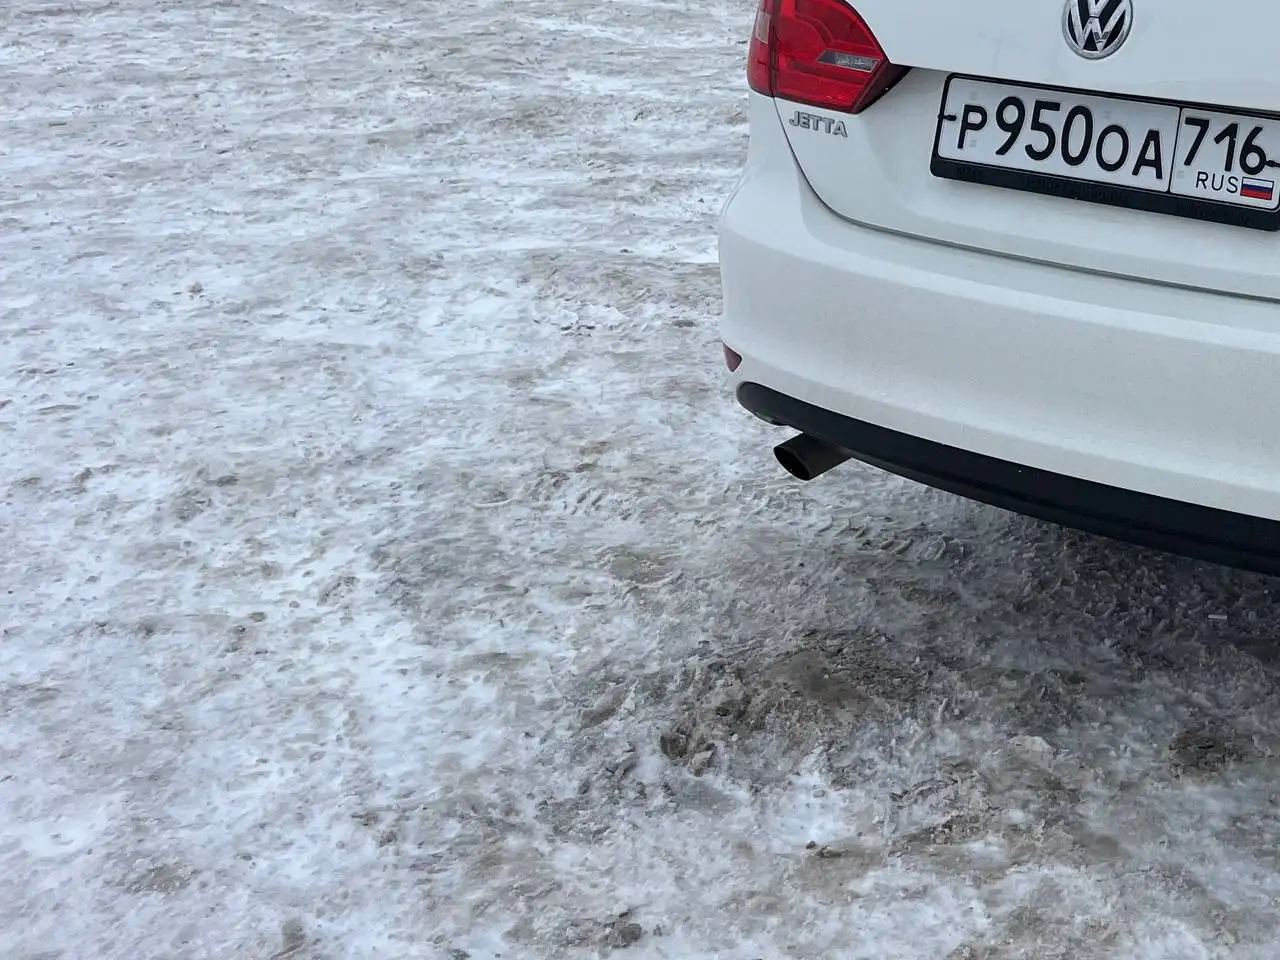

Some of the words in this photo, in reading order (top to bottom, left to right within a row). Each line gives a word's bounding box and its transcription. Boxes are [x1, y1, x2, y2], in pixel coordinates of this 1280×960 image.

[789, 110, 848, 138] JETTA
[1184, 117, 1267, 176] 716
[1195, 171, 1239, 194] RUS
